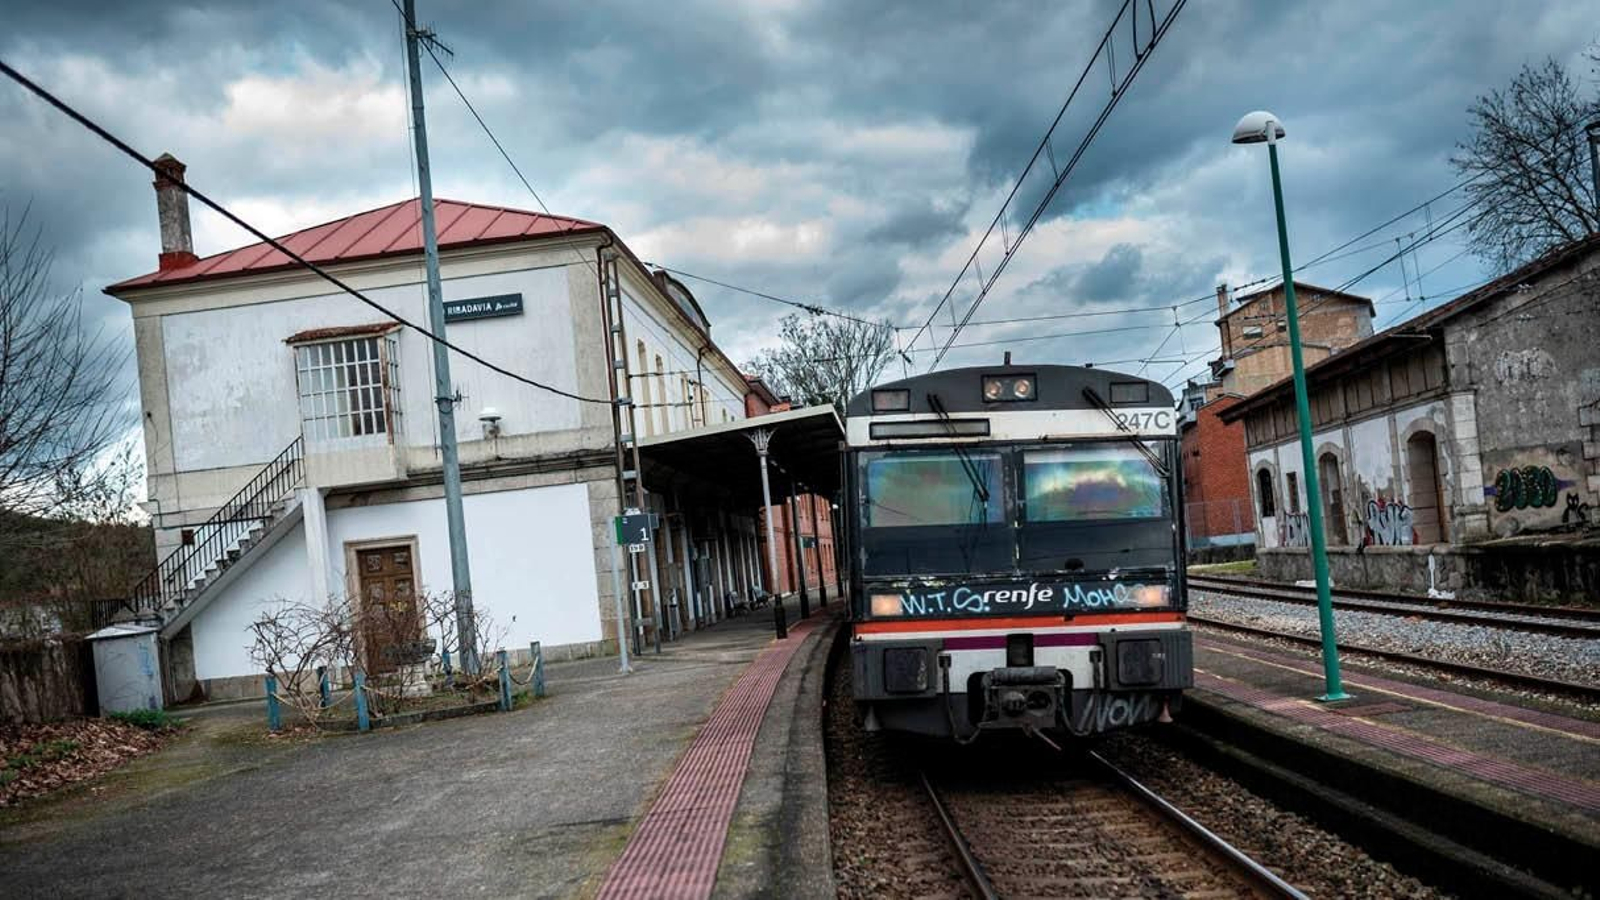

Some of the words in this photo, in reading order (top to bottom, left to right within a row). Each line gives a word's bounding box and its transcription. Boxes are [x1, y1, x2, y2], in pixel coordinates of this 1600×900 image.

[447, 302, 492, 316] RIBADAVIA
[640, 527, 650, 541] 1
[983, 582, 1054, 609] renfe
